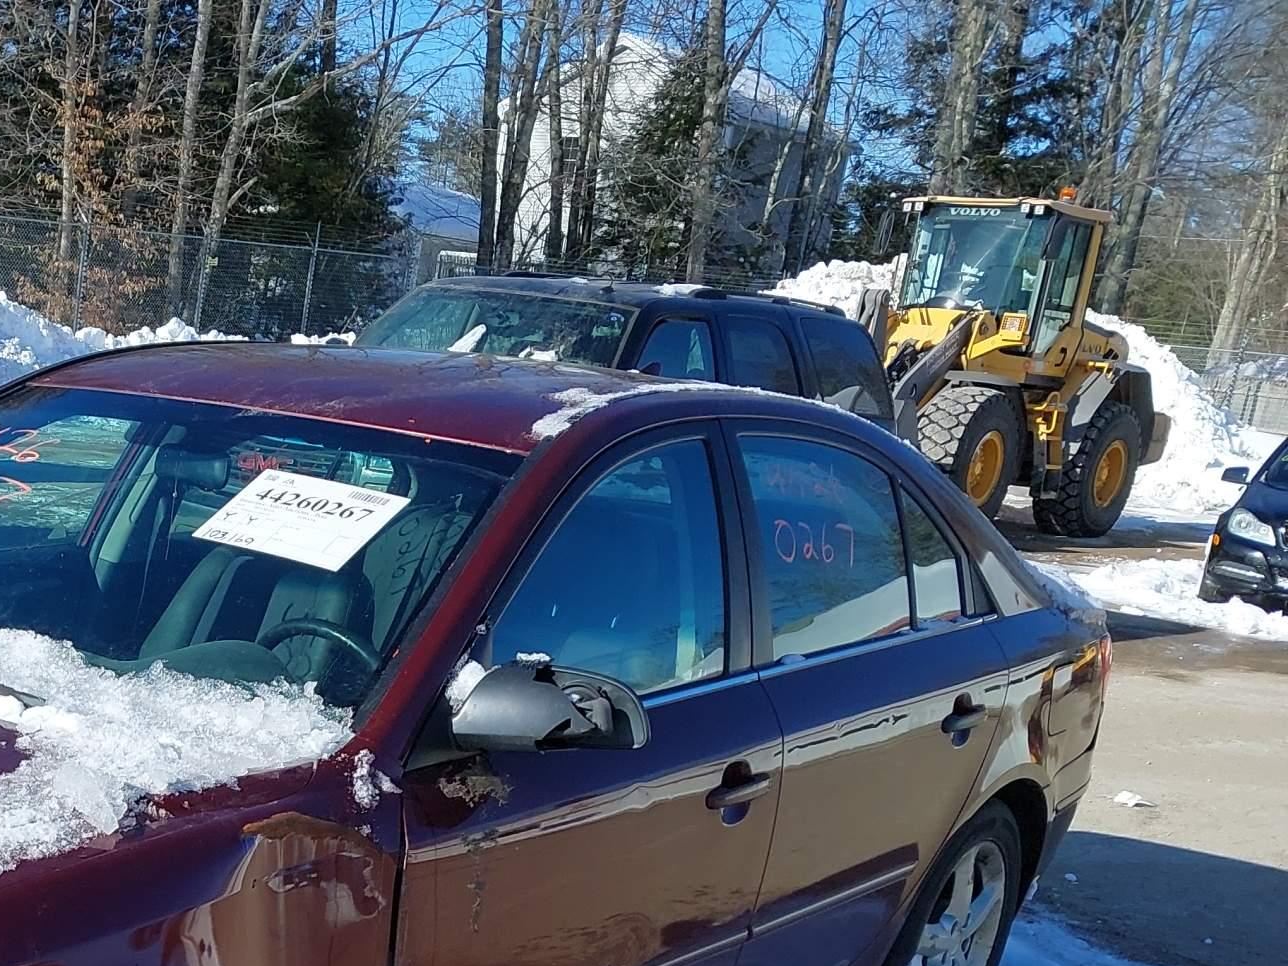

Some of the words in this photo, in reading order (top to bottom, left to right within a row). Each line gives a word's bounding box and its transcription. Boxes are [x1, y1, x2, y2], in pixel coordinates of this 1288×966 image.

[949, 207, 1001, 217] VOLVO
[255, 487, 376, 522] 44260267
[774, 519, 854, 569] 0267
